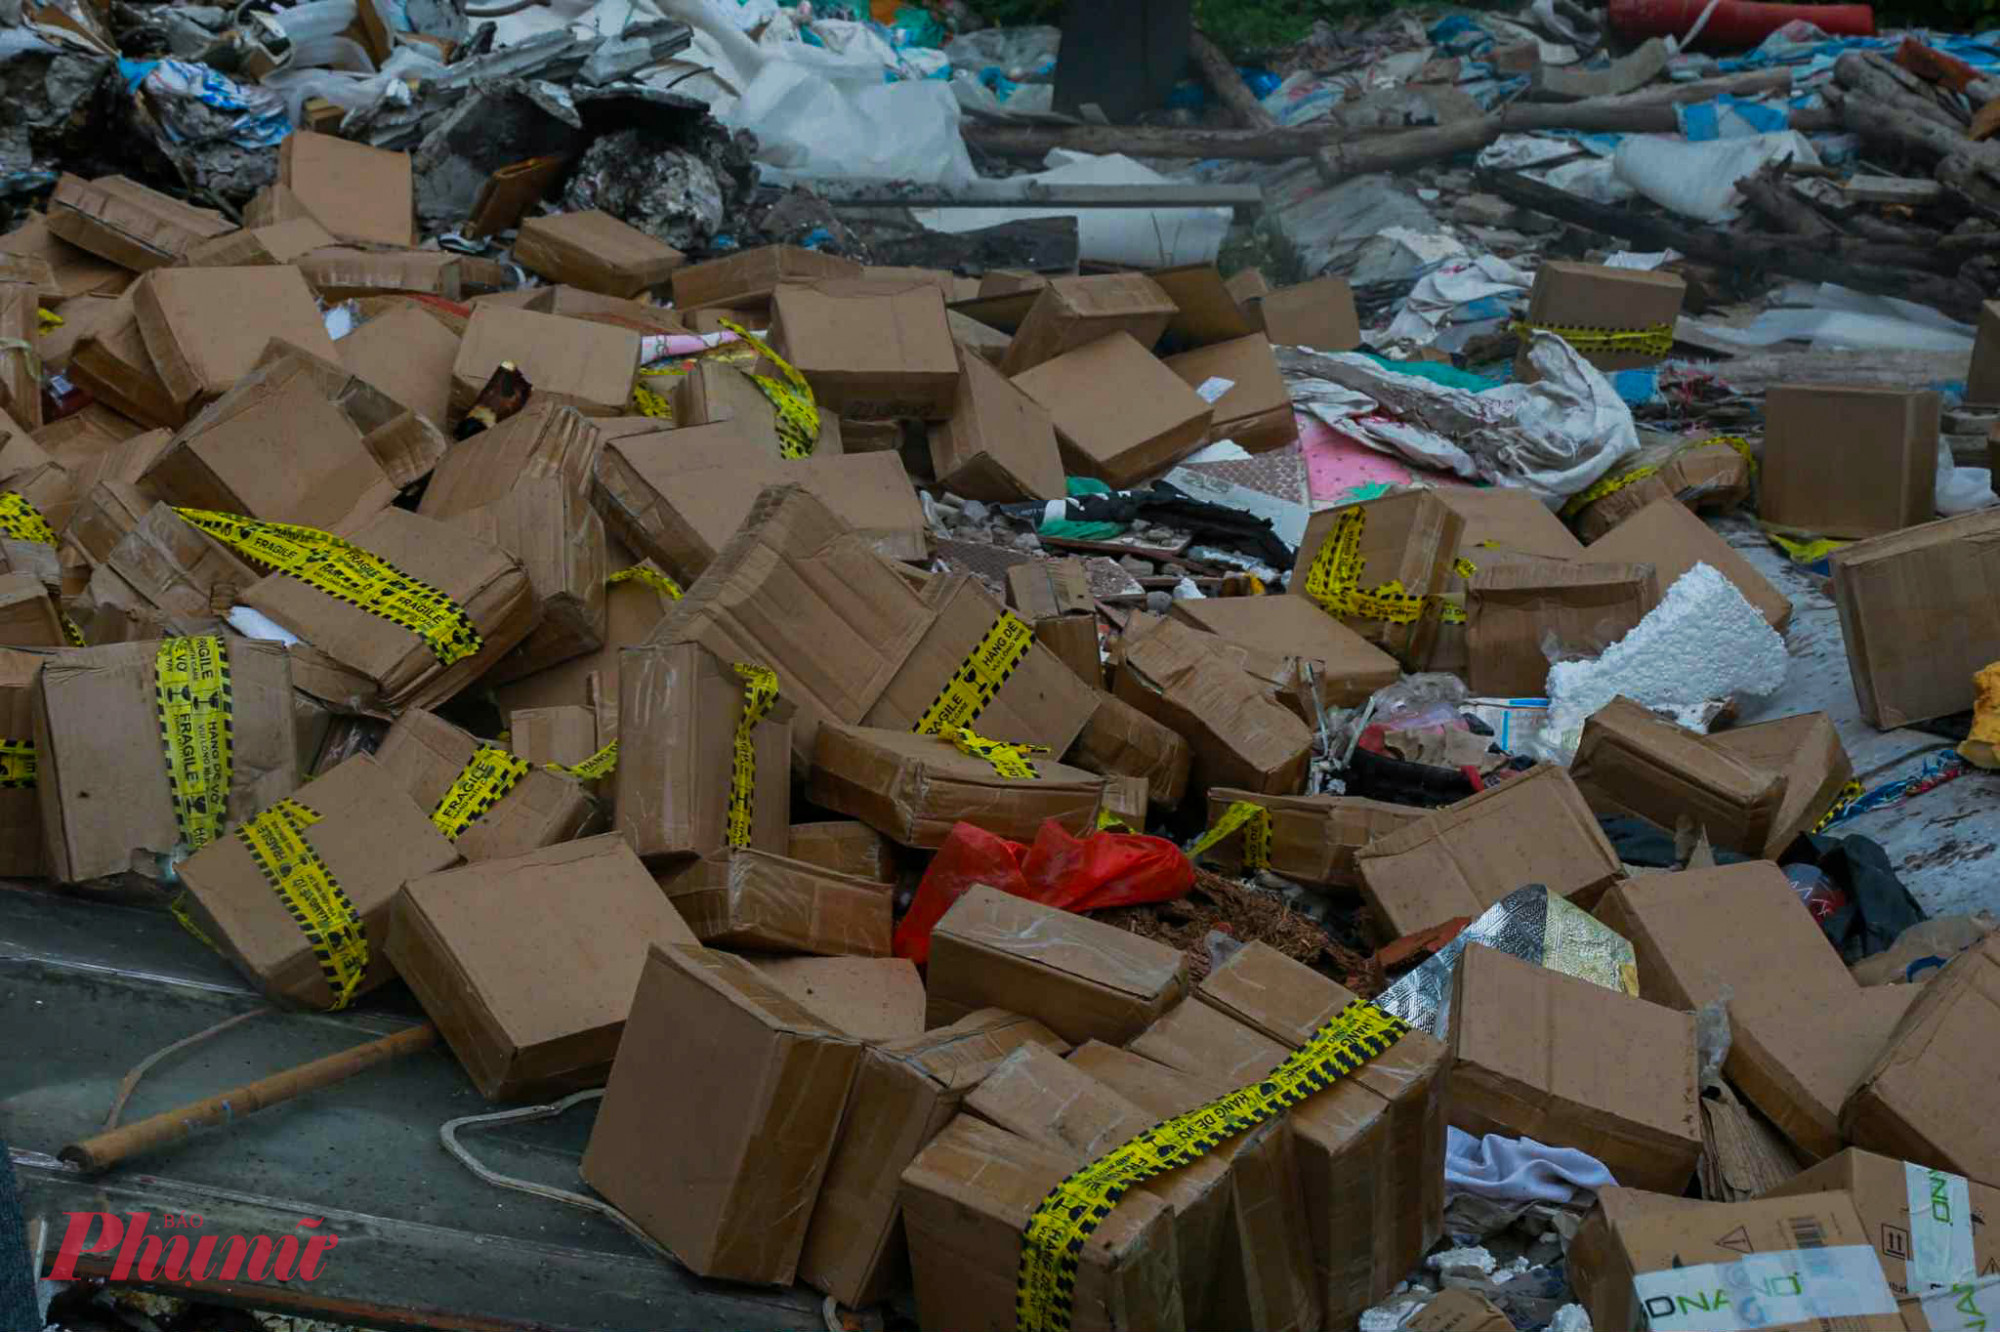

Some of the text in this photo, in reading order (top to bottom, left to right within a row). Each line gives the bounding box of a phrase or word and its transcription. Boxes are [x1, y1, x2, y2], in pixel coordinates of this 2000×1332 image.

[254, 537, 300, 560] FRAGILE
[344, 549, 382, 579] FRAGILE
[396, 595, 446, 625] FRAGILE
[179, 712, 199, 782] FRAGILE
[443, 760, 489, 817] FRAGILE
